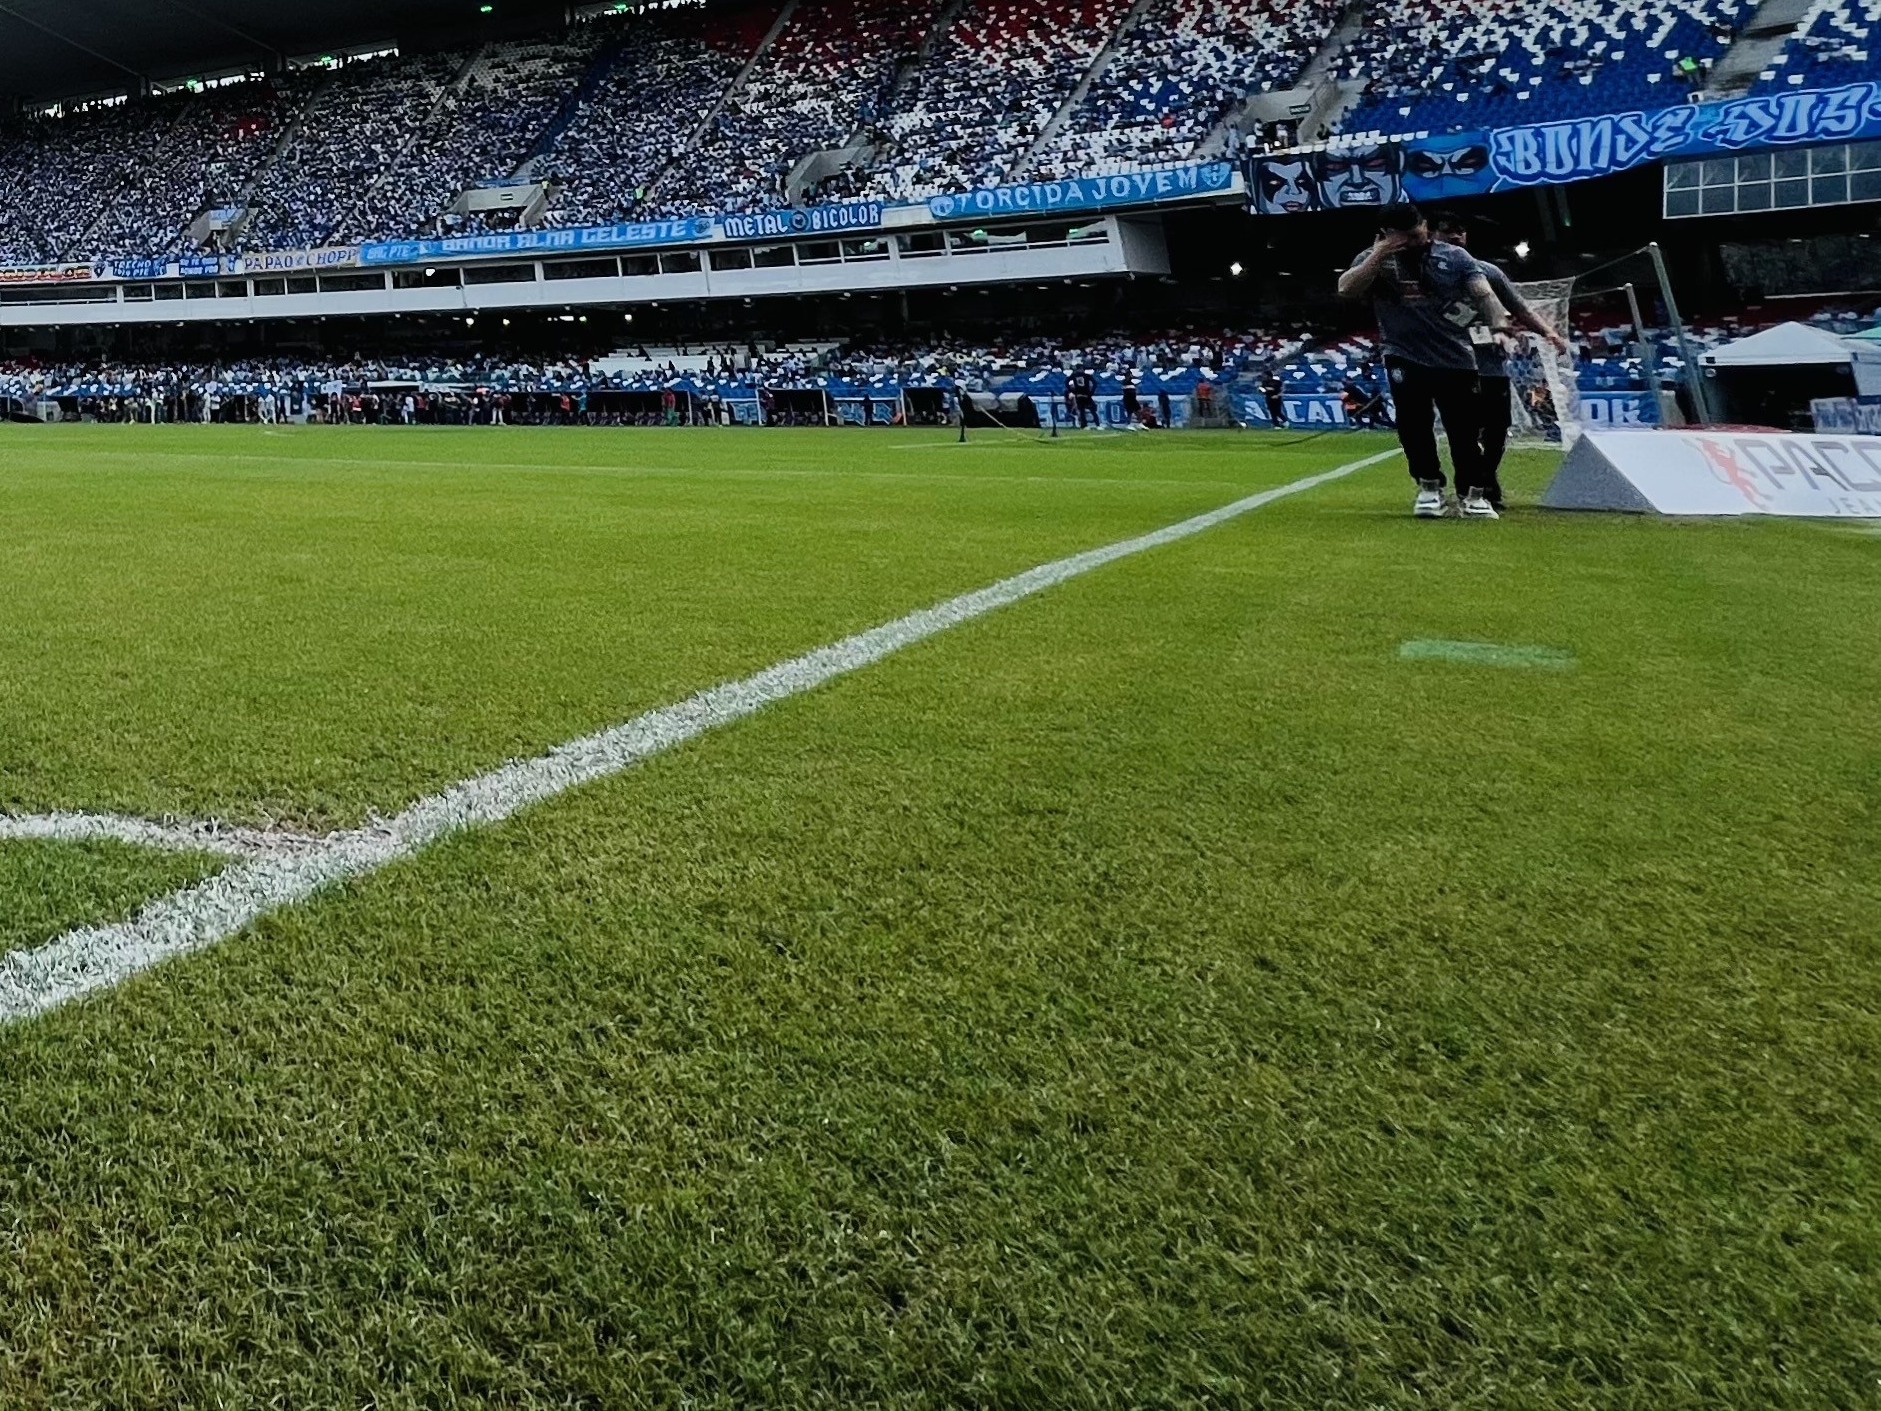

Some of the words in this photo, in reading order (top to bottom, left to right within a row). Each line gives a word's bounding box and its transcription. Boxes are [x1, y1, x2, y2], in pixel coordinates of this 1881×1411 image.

[955, 182, 1084, 210] TORCIDA
[1091, 166, 1198, 201] JOVEM
[724, 214, 789, 237] METAL
[812, 203, 879, 230] BICOLOR
